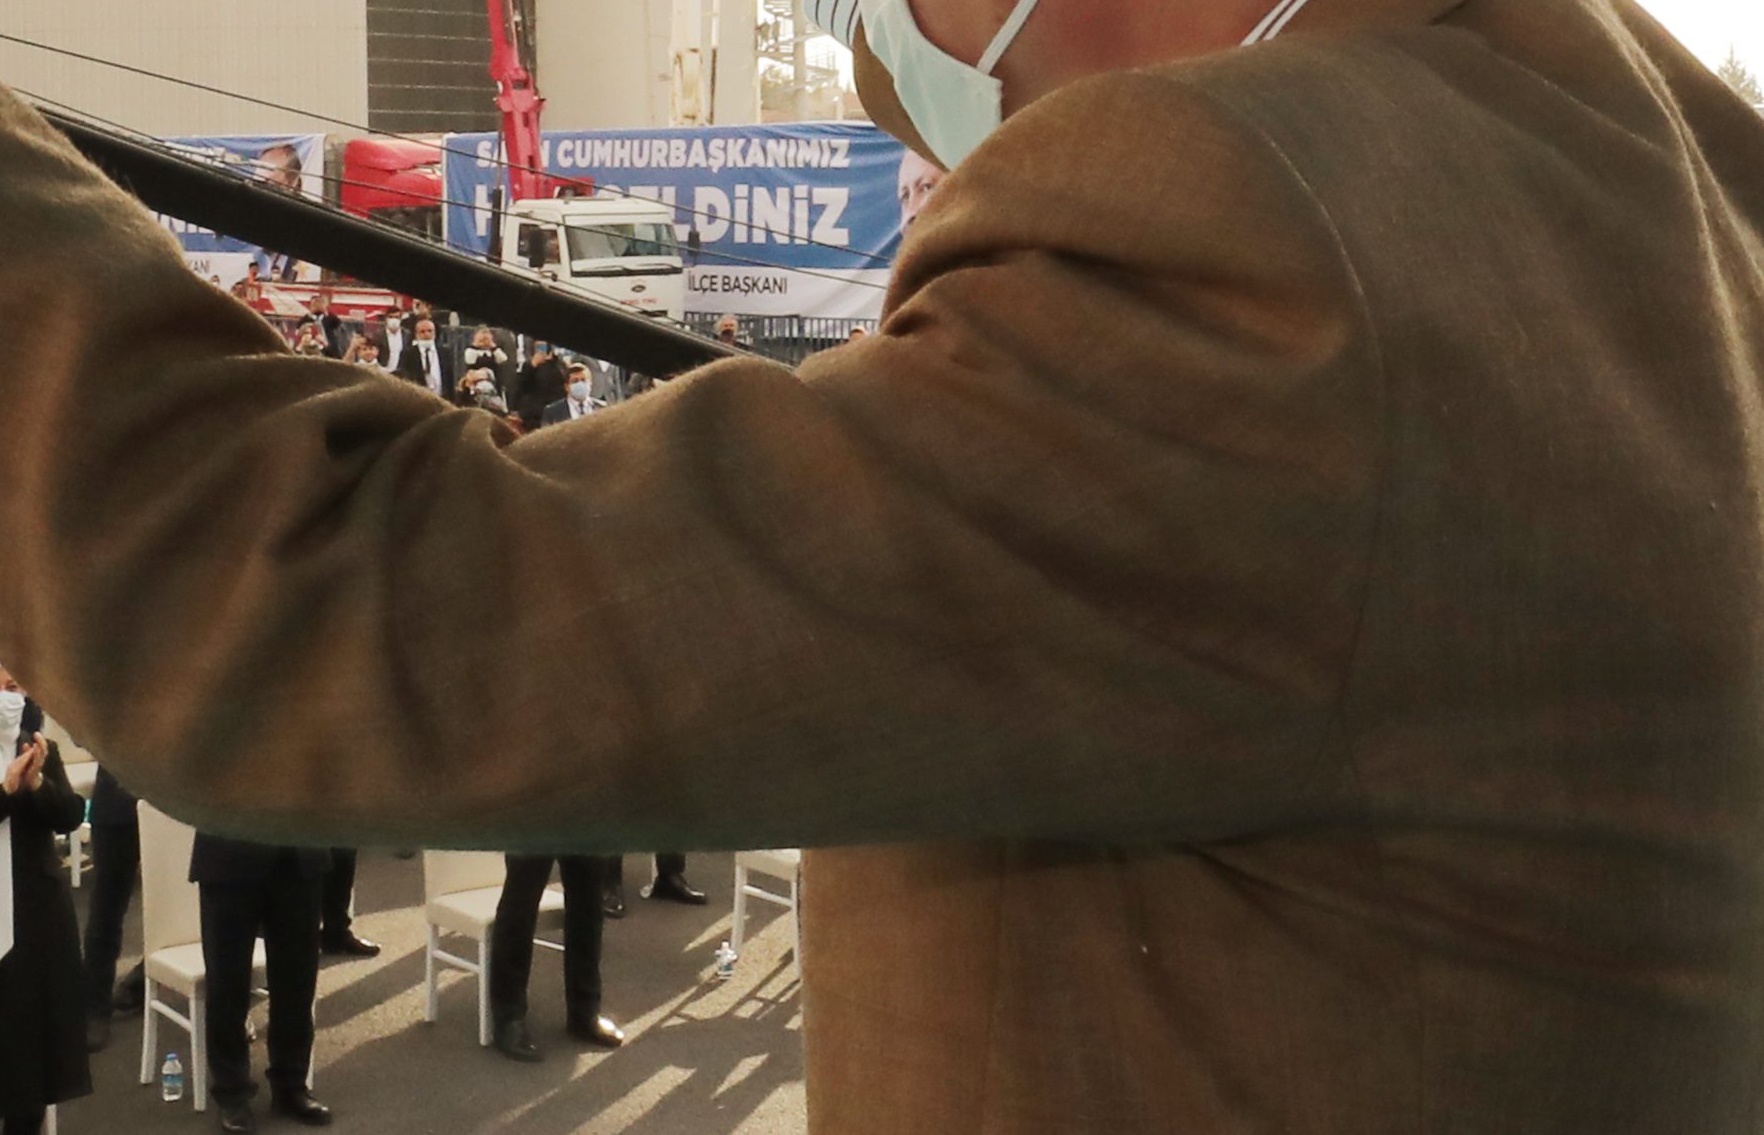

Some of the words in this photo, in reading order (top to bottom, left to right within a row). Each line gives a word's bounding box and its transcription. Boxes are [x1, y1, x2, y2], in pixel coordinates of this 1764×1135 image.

[557, 138, 851, 174] CUMHURBAŞKANIMIZ
[596, 184, 849, 245] LDİNİZ
[688, 271, 718, 295] İLÇE
[722, 274, 788, 297] BAŞKANI
